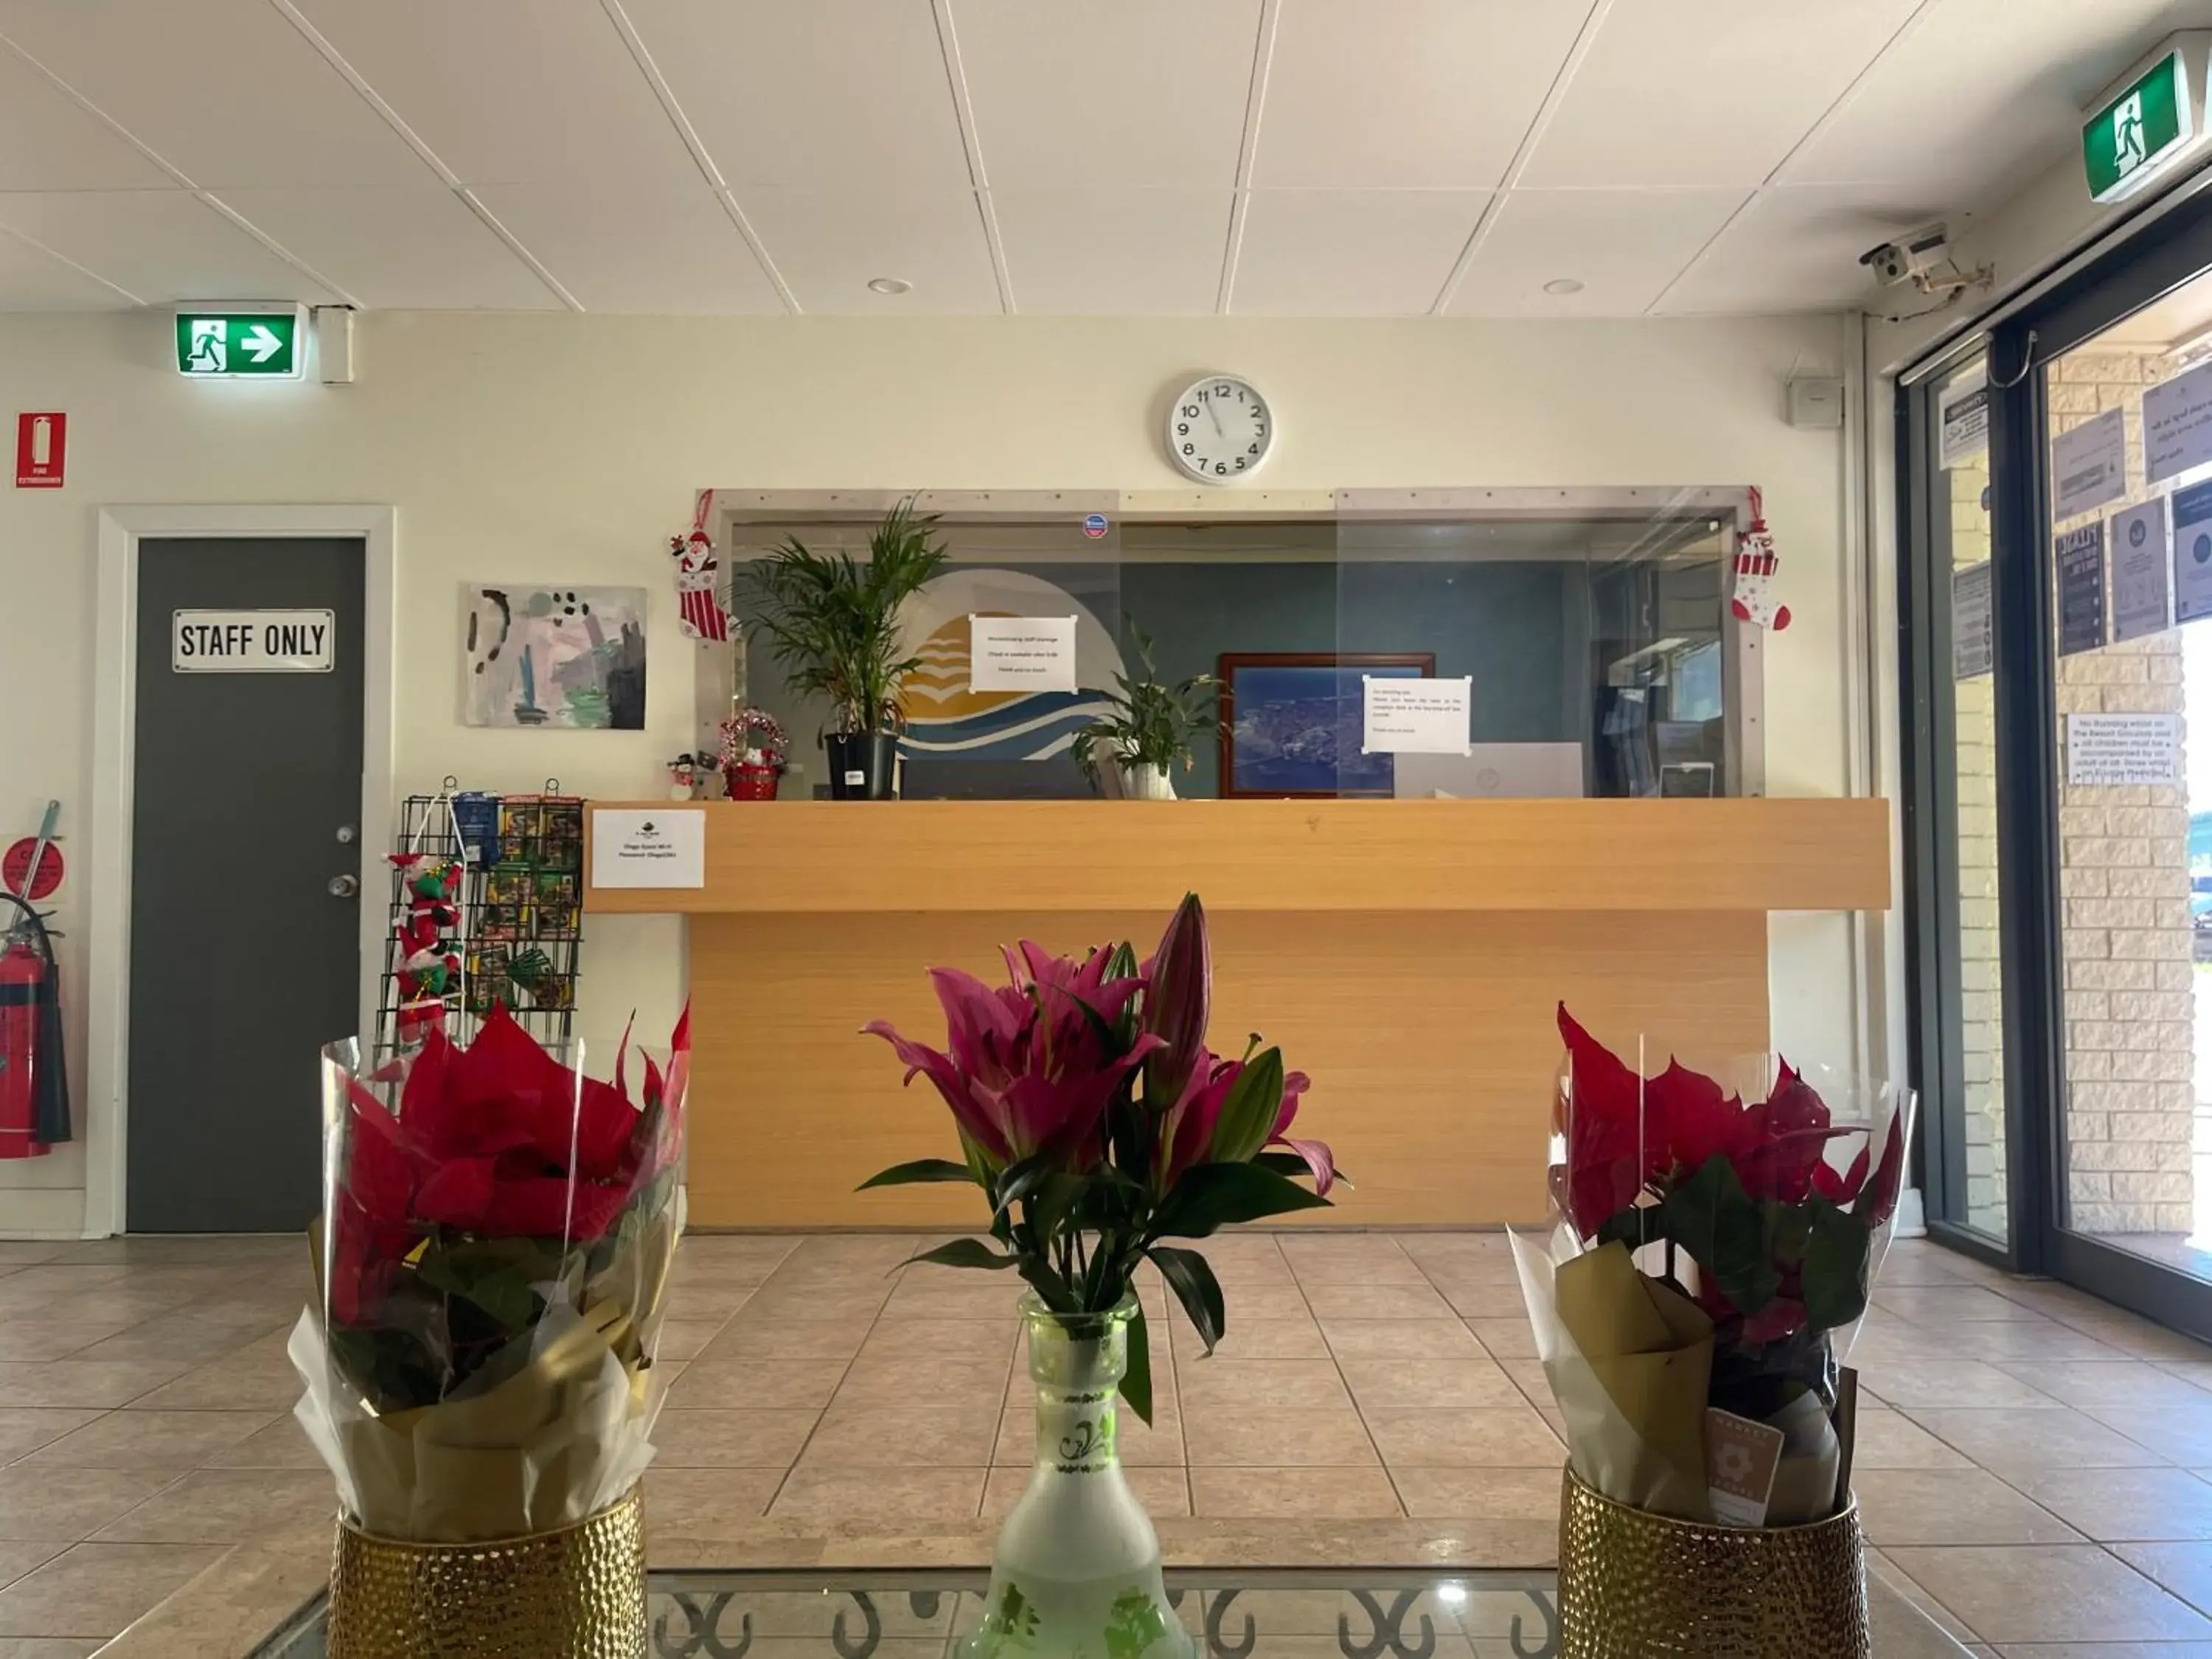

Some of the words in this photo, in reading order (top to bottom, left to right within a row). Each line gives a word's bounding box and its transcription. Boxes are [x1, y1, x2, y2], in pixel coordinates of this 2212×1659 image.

[1197, 391, 1208, 403] 11
[1214, 386, 1231, 397] 12
[1238, 391, 1244, 403] 1
[1182, 405, 1200, 418] 10
[1251, 406, 1262, 418] 2
[1178, 423, 1189, 436] 9
[1255, 424, 1265, 437] 3
[1183, 443, 1194, 455] 8
[1248, 443, 1259, 454] 4
[1197, 458, 1208, 470] 7
[1215, 462, 1226, 475] 6
[1236, 456, 1245, 470] 5
[181, 625, 253, 655] STAFF
[265, 625, 325, 655] ONLY
